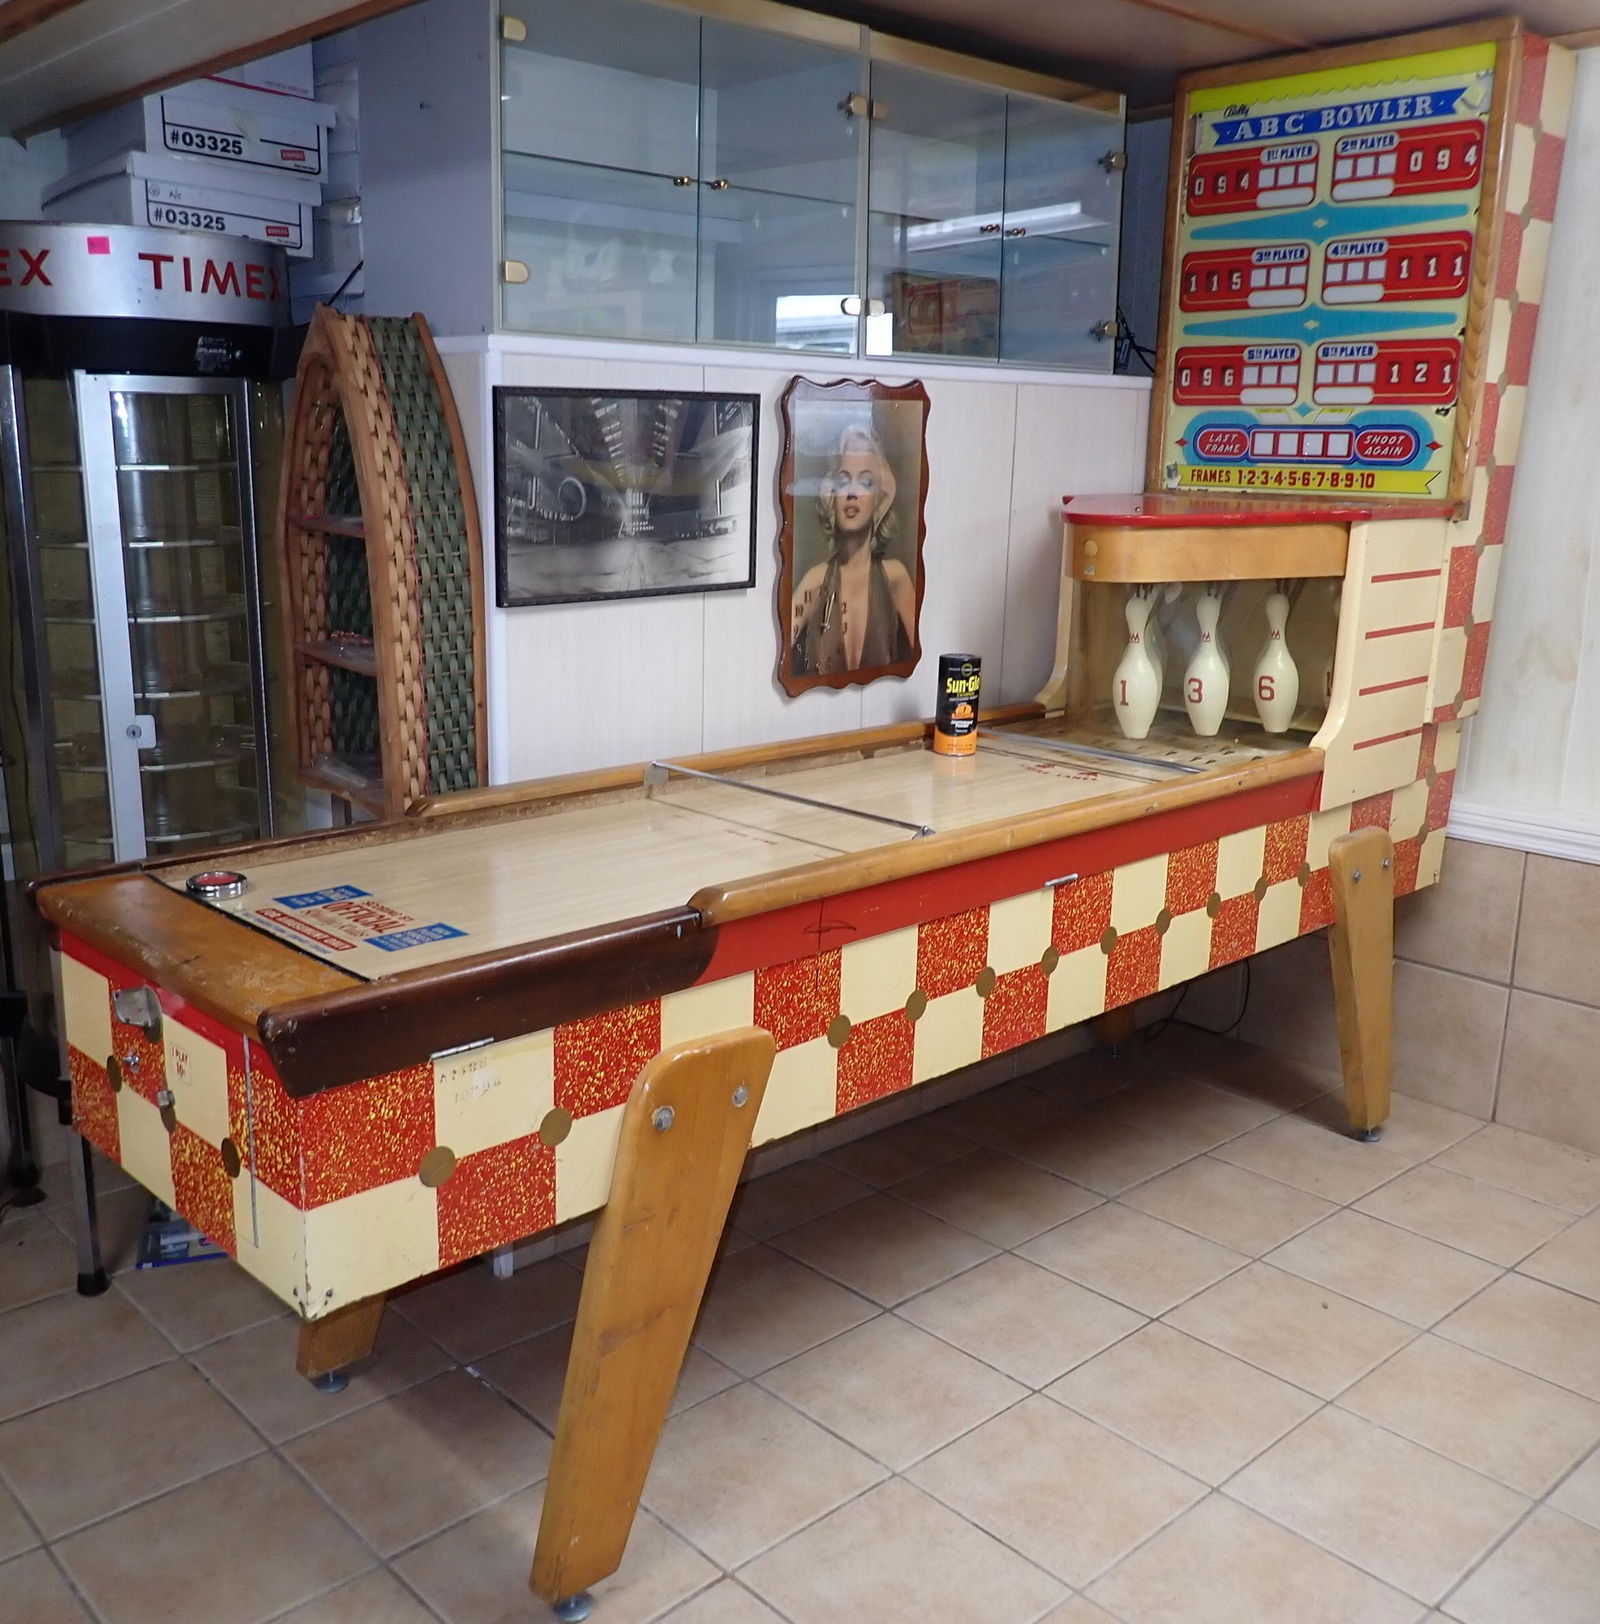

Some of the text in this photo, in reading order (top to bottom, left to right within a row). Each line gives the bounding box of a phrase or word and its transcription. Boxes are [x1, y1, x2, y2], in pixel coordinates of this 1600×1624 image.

[1233, 96, 1434, 141] ABC BOWLER
[170, 129, 243, 155] #03325
[1359, 135, 1396, 150] PLAYER
[1280, 145, 1313, 161] PLAYER
[154, 207, 226, 231] #03325
[1273, 248, 1305, 261] PLAYER
[1350, 242, 1384, 256] PLAYER
[138, 252, 281, 302] TIMEX
[1264, 348, 1296, 360] PLAYER
[1339, 345, 1374, 357] PLAYER
[1209, 433, 1239, 442] LAST
[1364, 435, 1405, 444] SHOOT
[1204, 443, 1241, 453] FRAME
[1364, 446, 1403, 456] AGAIN
[1191, 469, 1231, 483] FRAMES
[1120, 680, 1129, 706] 1
[1188, 678, 1203, 704] 3
[1258, 675, 1275, 701] 6
[321, 901, 406, 933] OFFICIAL
